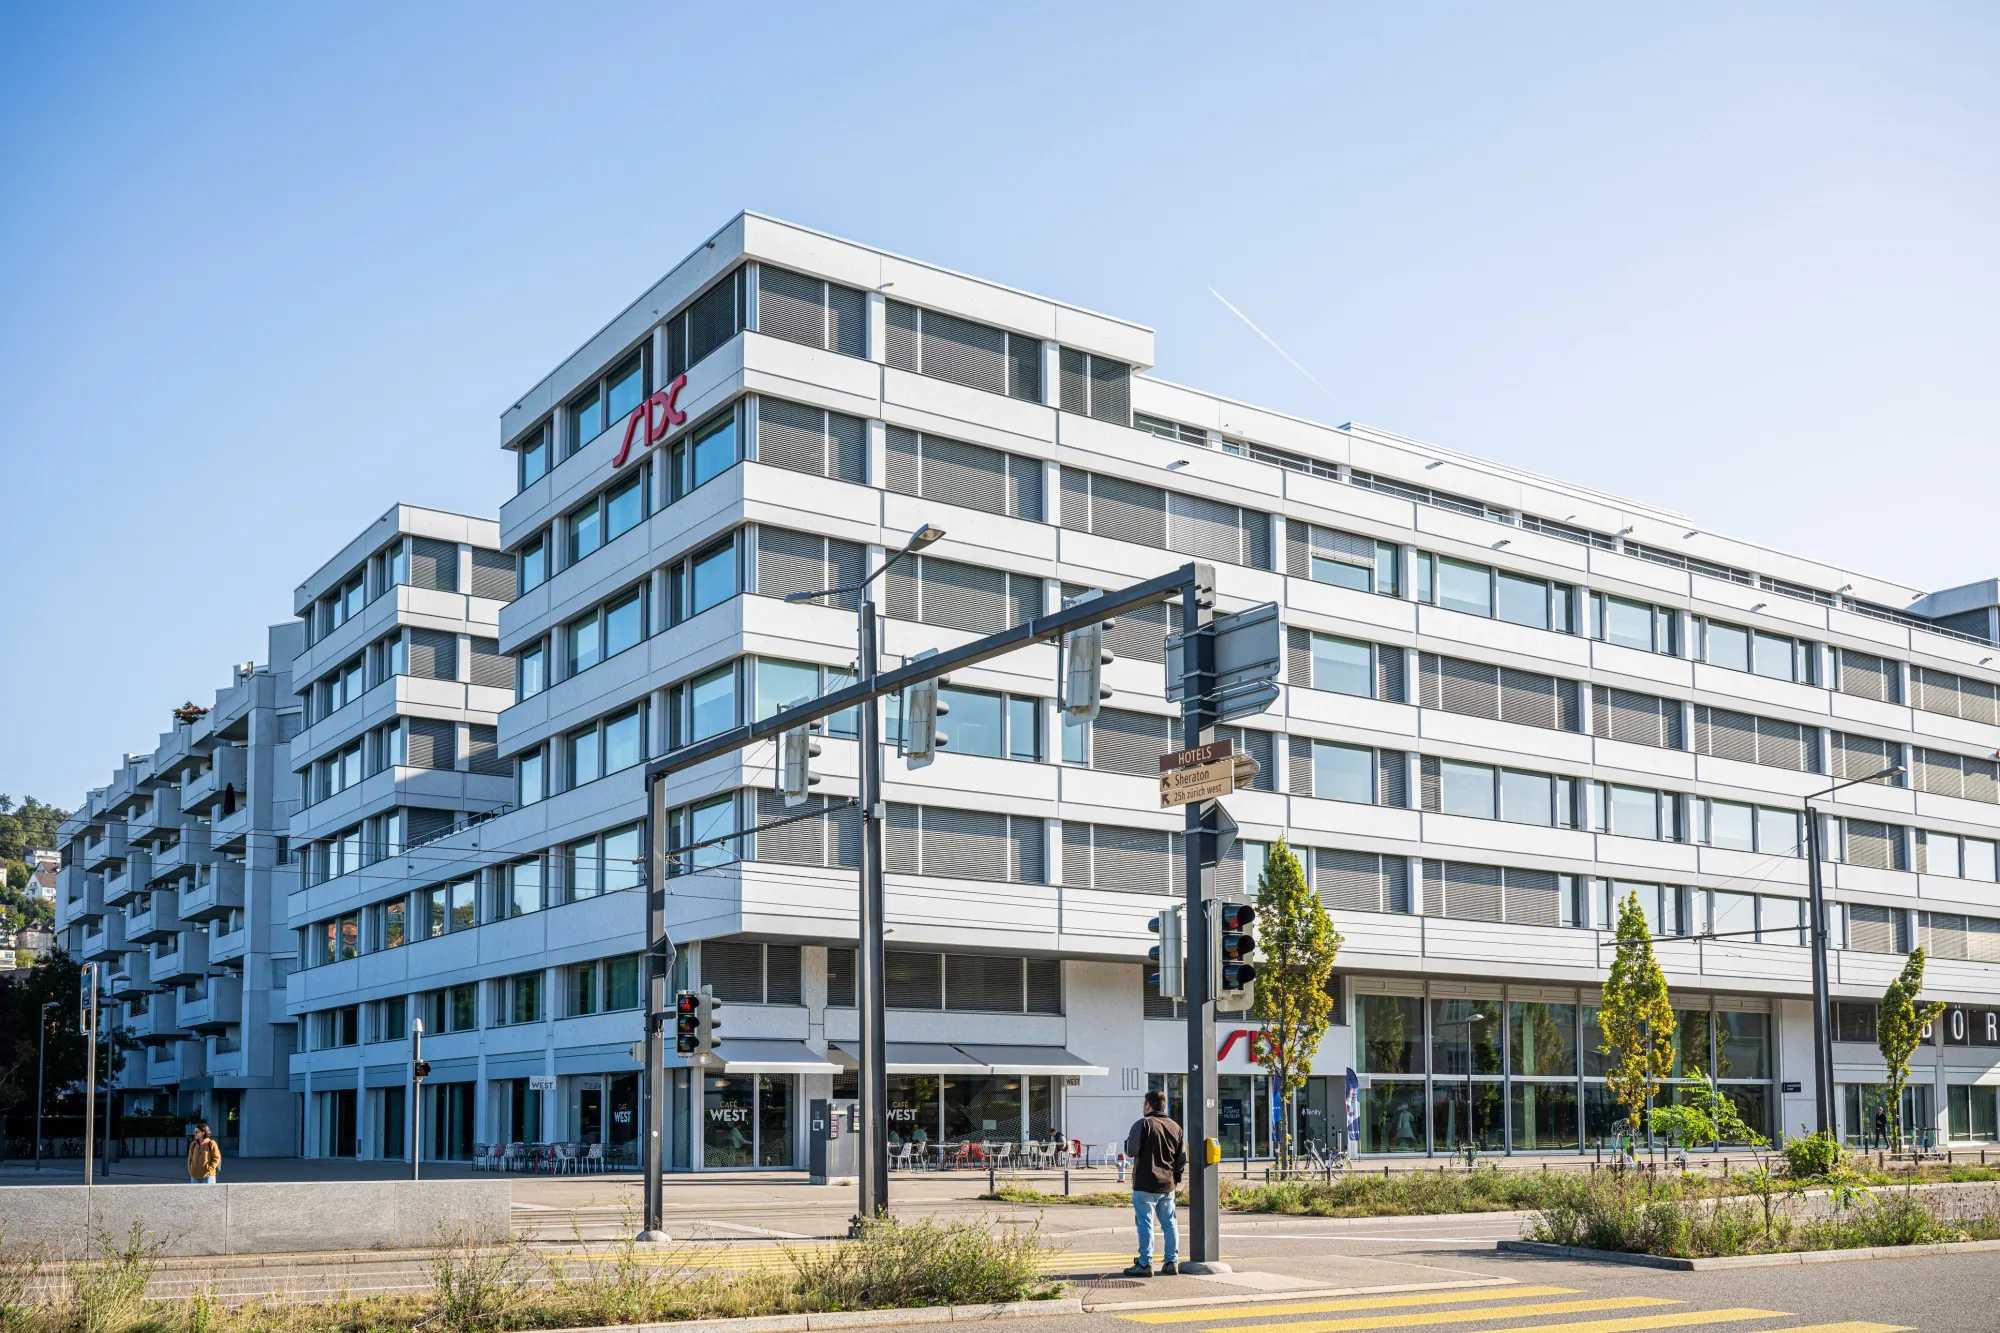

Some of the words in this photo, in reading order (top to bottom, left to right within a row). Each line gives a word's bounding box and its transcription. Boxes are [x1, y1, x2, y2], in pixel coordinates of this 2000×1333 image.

[612, 374, 687, 468] SIX
[1178, 746, 1212, 765] HOTELS
[1175, 770, 1209, 786] Sheraton
[1174, 790, 1186, 802] 25h
[1187, 787, 1206, 799] zürich
[1207, 784, 1222, 795] west
[1065, 1078, 1080, 1086] WEST
[1121, 1067, 1139, 1091] 110
[719, 1099, 738, 1108] CAFÉ
[892, 1100, 909, 1108] CAFÉ
[614, 1111, 632, 1122] WEST
[710, 1109, 748, 1121] WEST
[886, 1109, 918, 1121] WEST
